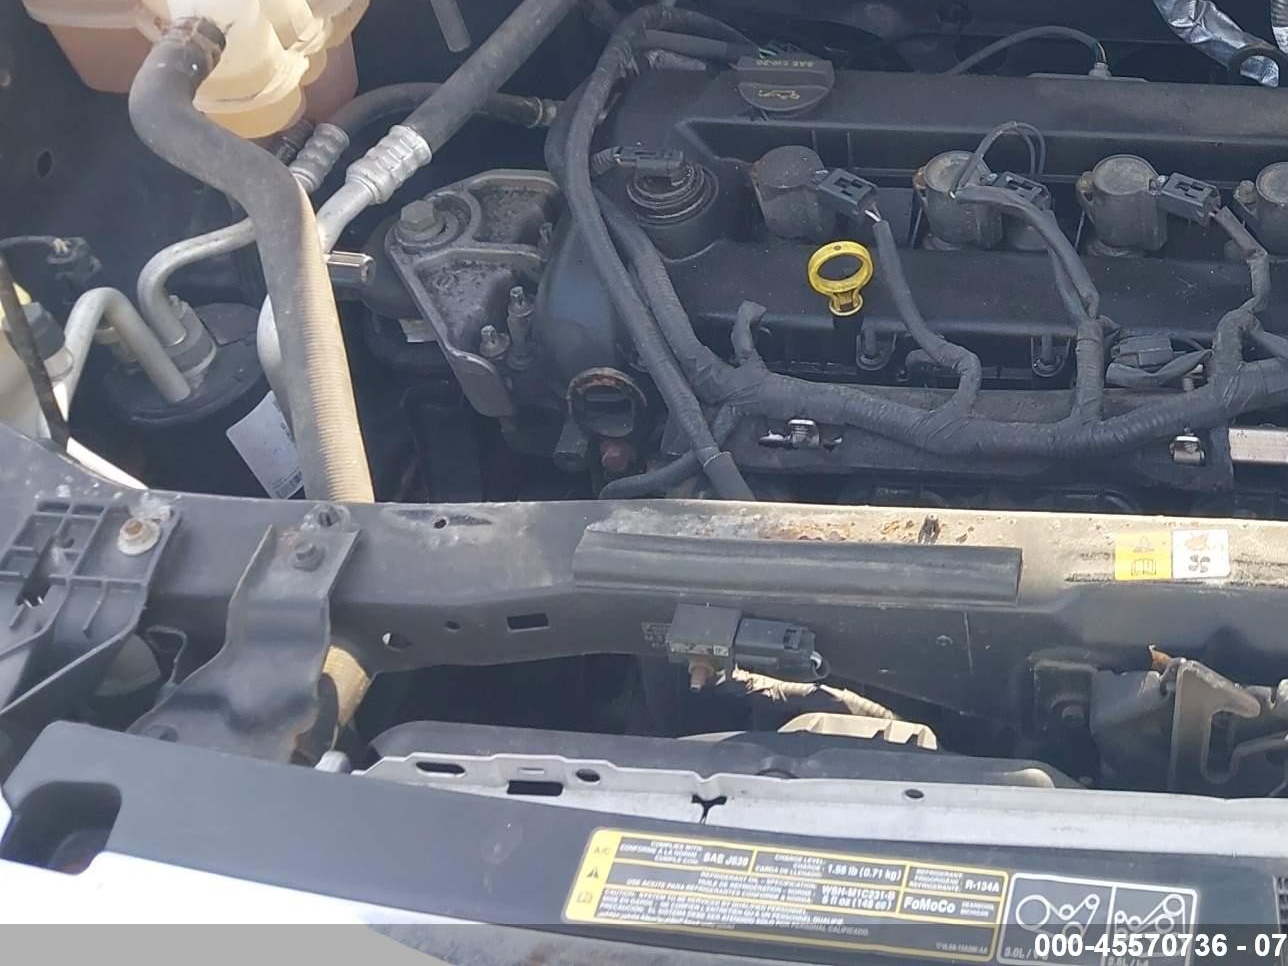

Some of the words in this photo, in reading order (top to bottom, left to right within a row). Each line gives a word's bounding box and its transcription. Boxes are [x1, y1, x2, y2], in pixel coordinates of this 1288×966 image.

[847, 866, 858, 877] lb
[965, 879, 1000, 893] R-134A
[904, 896, 956, 914] FoMoCo
